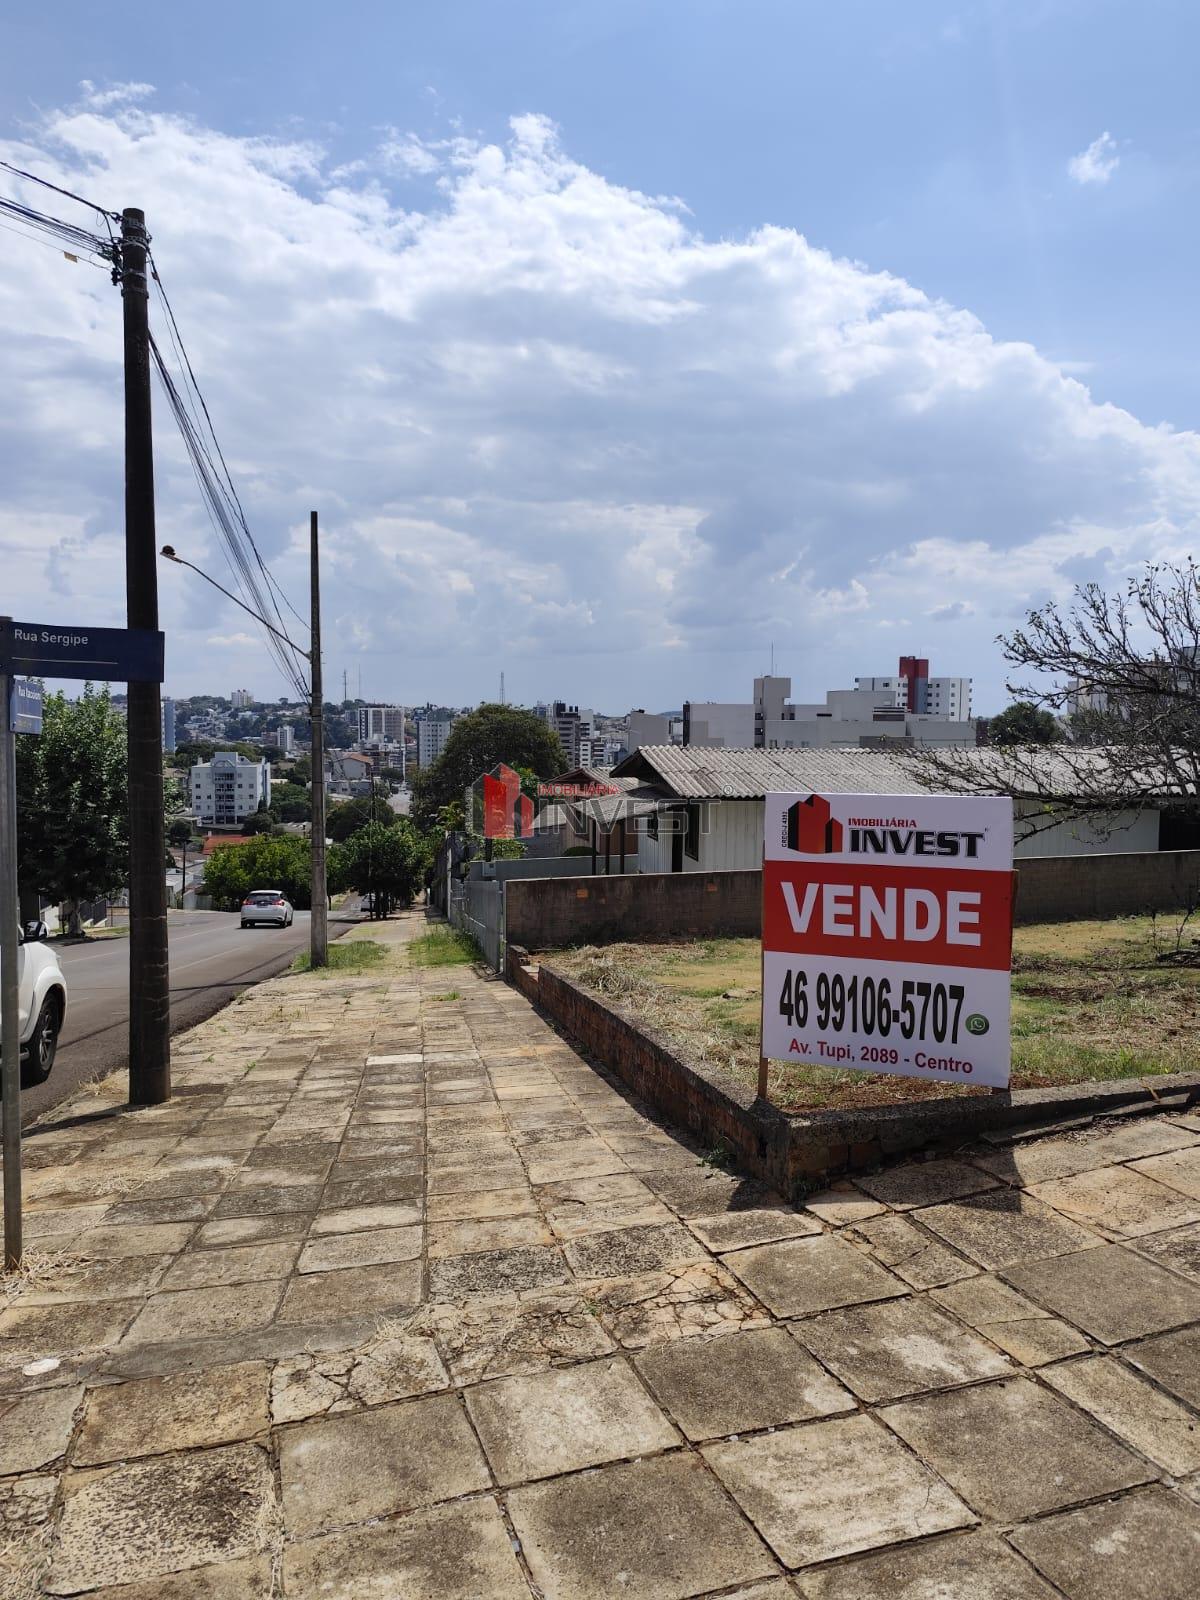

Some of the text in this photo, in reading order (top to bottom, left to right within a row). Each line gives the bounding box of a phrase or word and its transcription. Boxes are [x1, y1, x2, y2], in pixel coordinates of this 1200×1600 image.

[14, 629, 89, 647] Rua Sergipe
[848, 817, 917, 828] IMOBILIÁRIA
[848, 827, 986, 858] INVEST
[780, 881, 982, 947] VENDE
[779, 969, 965, 1044] 46 99106-5707
[788, 1038, 812, 1055] Av.
[817, 1040, 856, 1062] Tupi,
[860, 1045, 899, 1065] 2089
[914, 1052, 974, 1074] Centro
